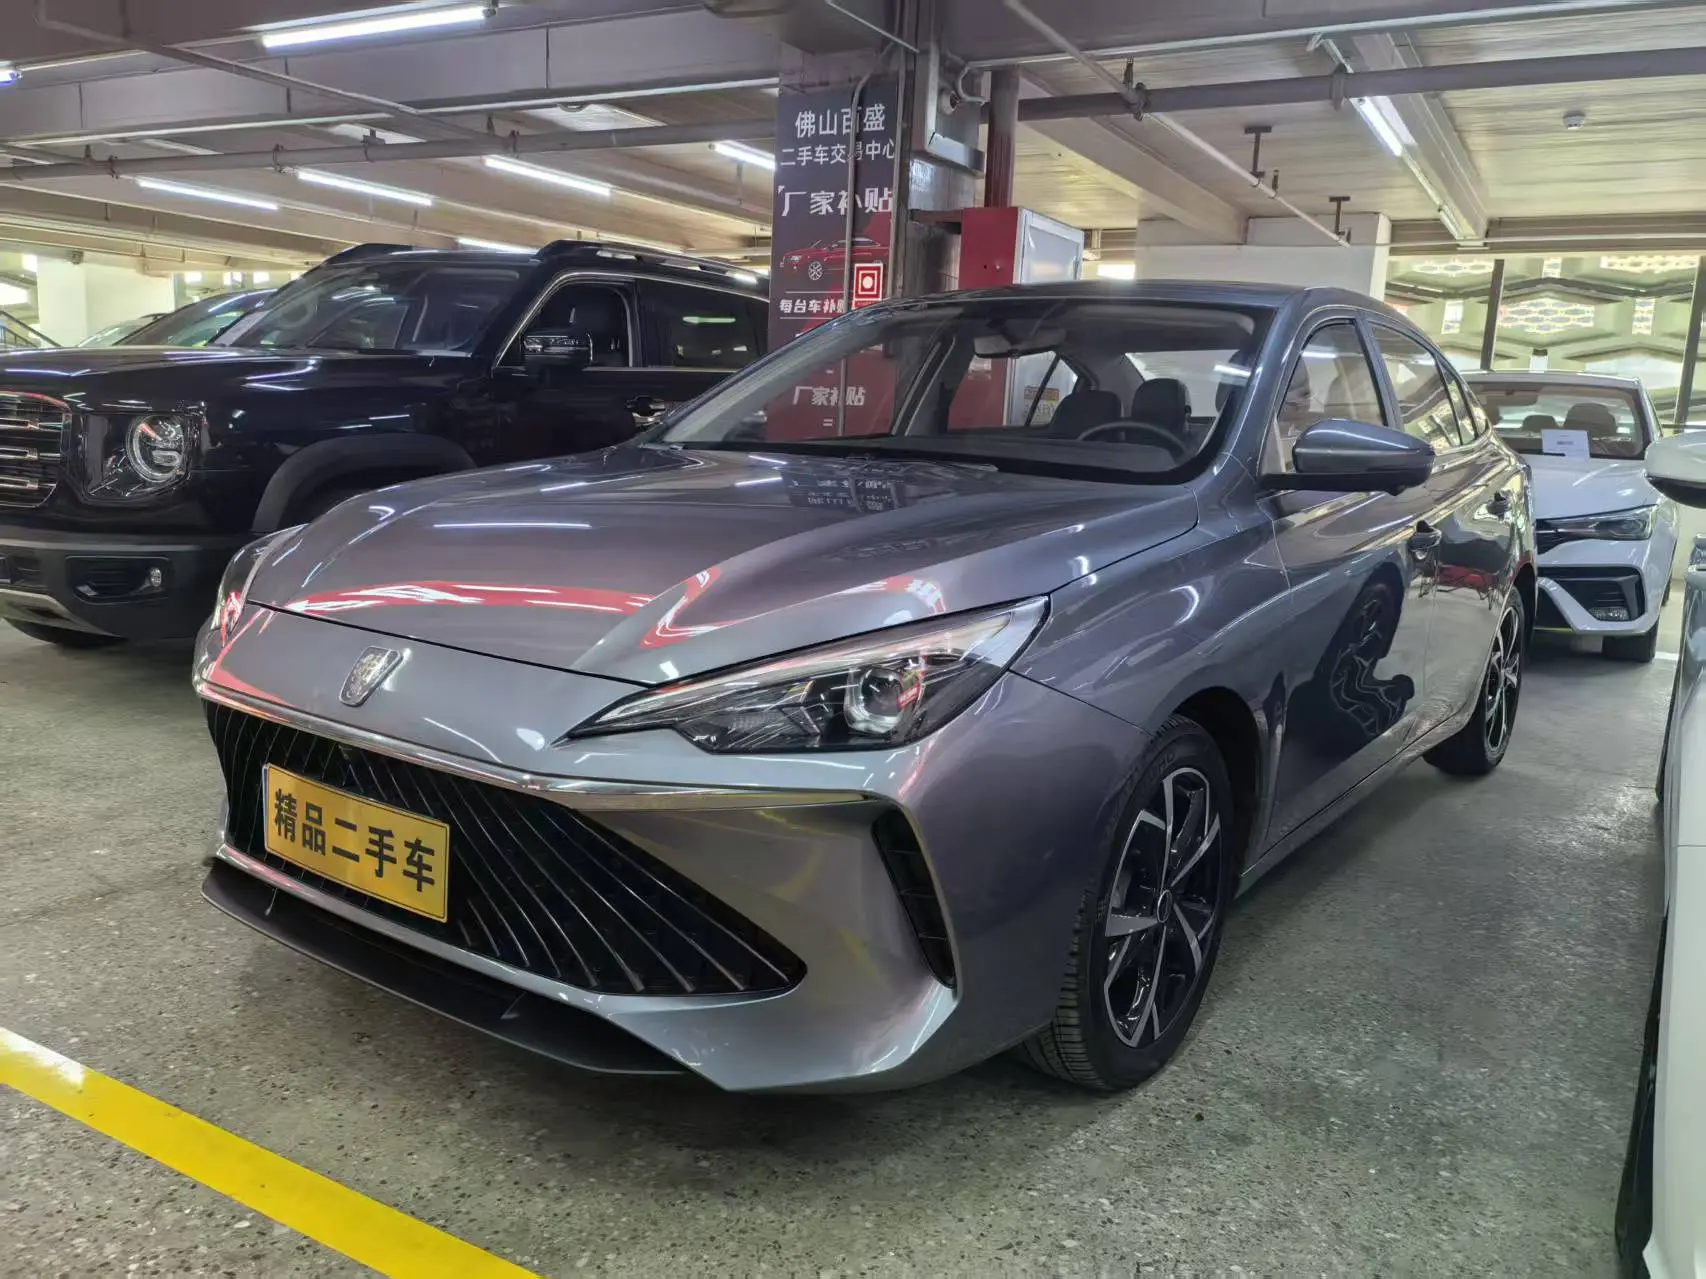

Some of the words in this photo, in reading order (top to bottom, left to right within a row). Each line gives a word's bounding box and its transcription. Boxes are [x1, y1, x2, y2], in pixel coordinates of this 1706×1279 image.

[795, 103, 885, 138] 佛山百盛
[274, 788, 435, 892] 精品二手车
